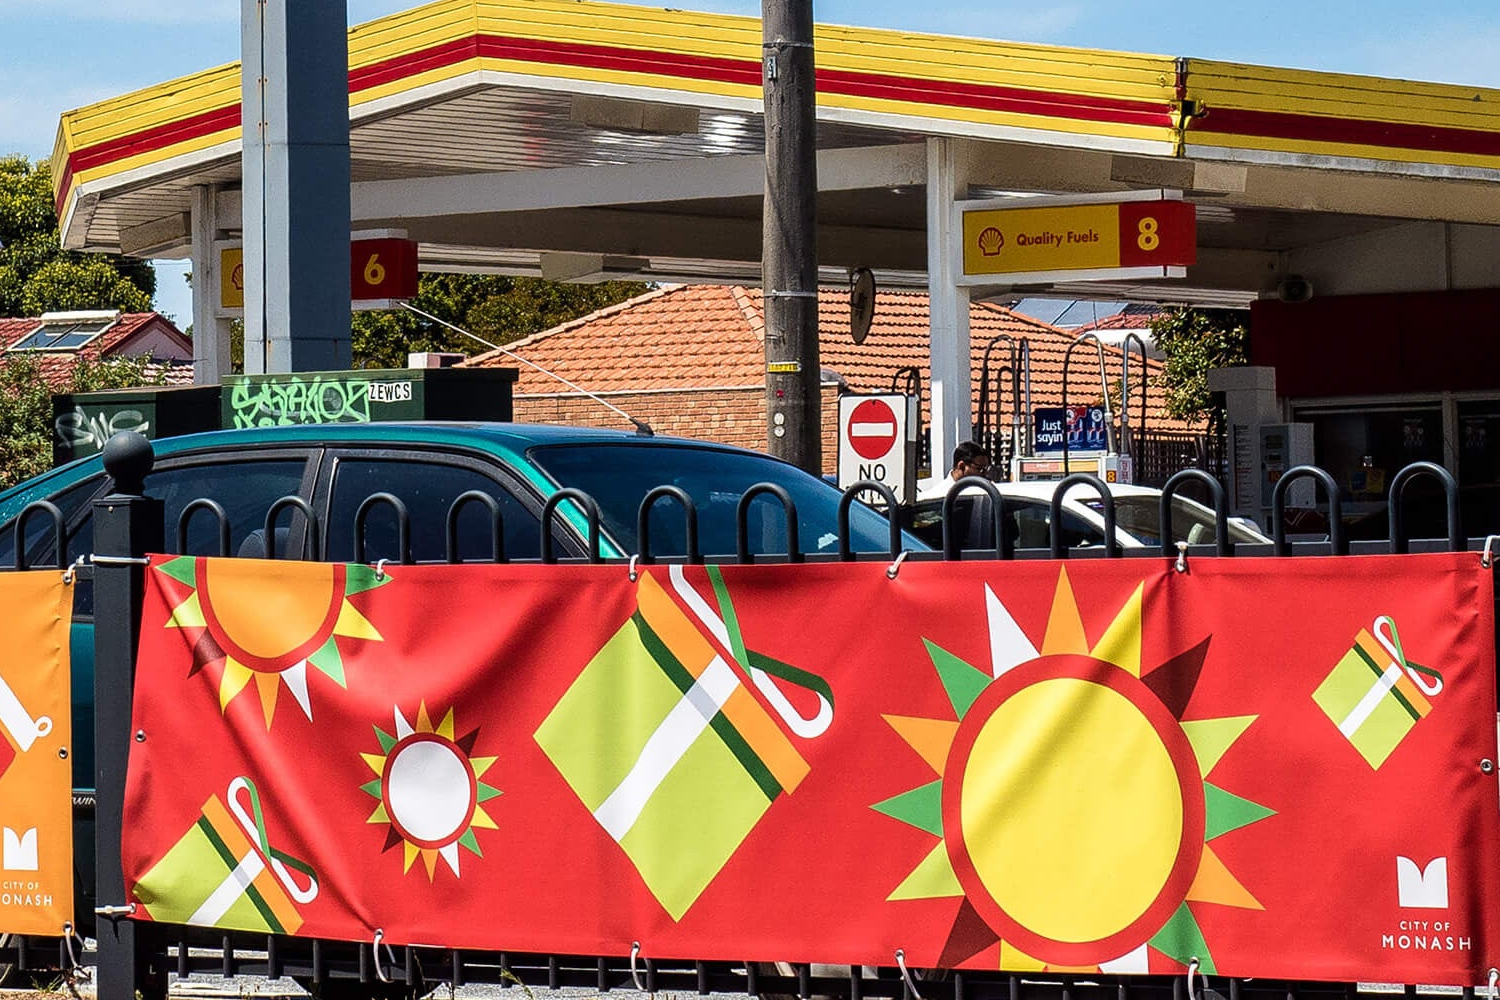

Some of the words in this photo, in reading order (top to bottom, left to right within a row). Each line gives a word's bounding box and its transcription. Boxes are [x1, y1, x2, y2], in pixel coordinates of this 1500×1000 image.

[1016, 231, 1063, 247] Quality
[1067, 229, 1100, 243] Fuels
[1136, 217, 1160, 251] 8
[364, 253, 386, 286] 6
[1041, 419, 1062, 431] Just
[859, 463, 886, 481] NO
[1107, 471, 1116, 482] 8
[3, 881, 23, 890] CITY
[27, 882, 40, 890] OF
[1400, 920, 1428, 931] CITY
[1433, 921, 1451, 932] OF
[1382, 934, 1471, 951] MONASH
